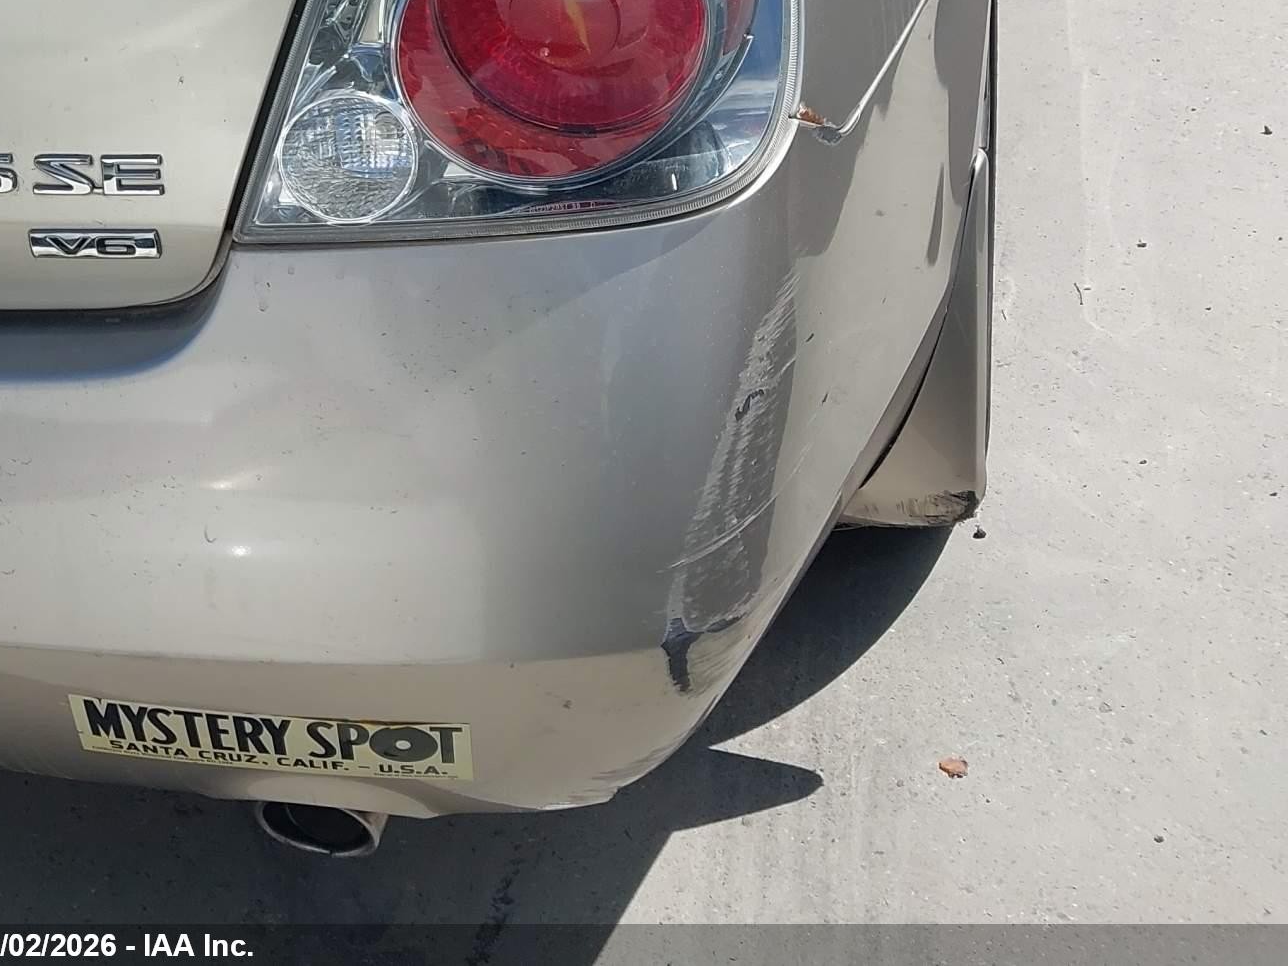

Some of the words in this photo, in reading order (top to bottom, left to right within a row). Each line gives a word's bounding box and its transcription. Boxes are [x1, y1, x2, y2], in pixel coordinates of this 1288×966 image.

[31, 152, 166, 197] SE
[45, 235, 138, 256] V6
[83, 698, 292, 756] MYSTERY
[305, 720, 463, 765] SPOT
[109, 739, 189, 758] SANTA
[198, 750, 269, 767] CRUZ,
[276, 757, 350, 771] CALIF.
[378, 764, 449, 776] U.S.A.
